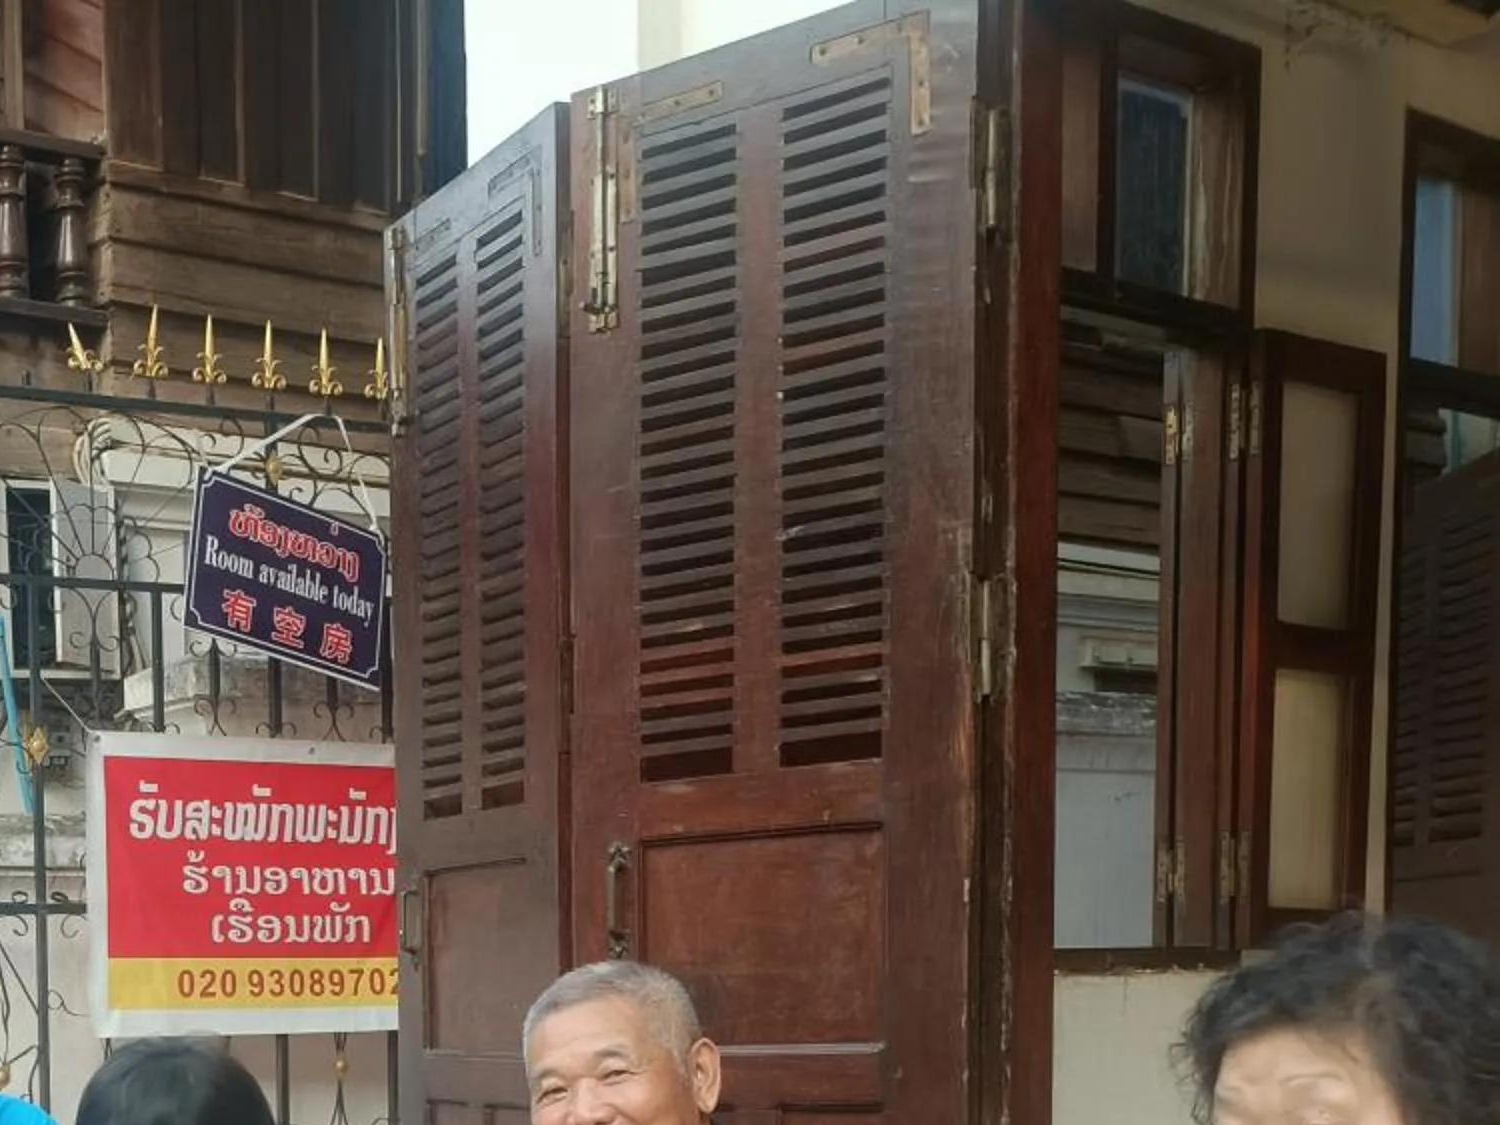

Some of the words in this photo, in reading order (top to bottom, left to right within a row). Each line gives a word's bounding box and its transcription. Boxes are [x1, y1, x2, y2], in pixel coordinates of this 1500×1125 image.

[204, 534, 254, 579] Room
[259, 563, 329, 605] available
[333, 586, 375, 629] today
[220, 588, 353, 665] 有空房
[177, 968, 238, 998] 020
